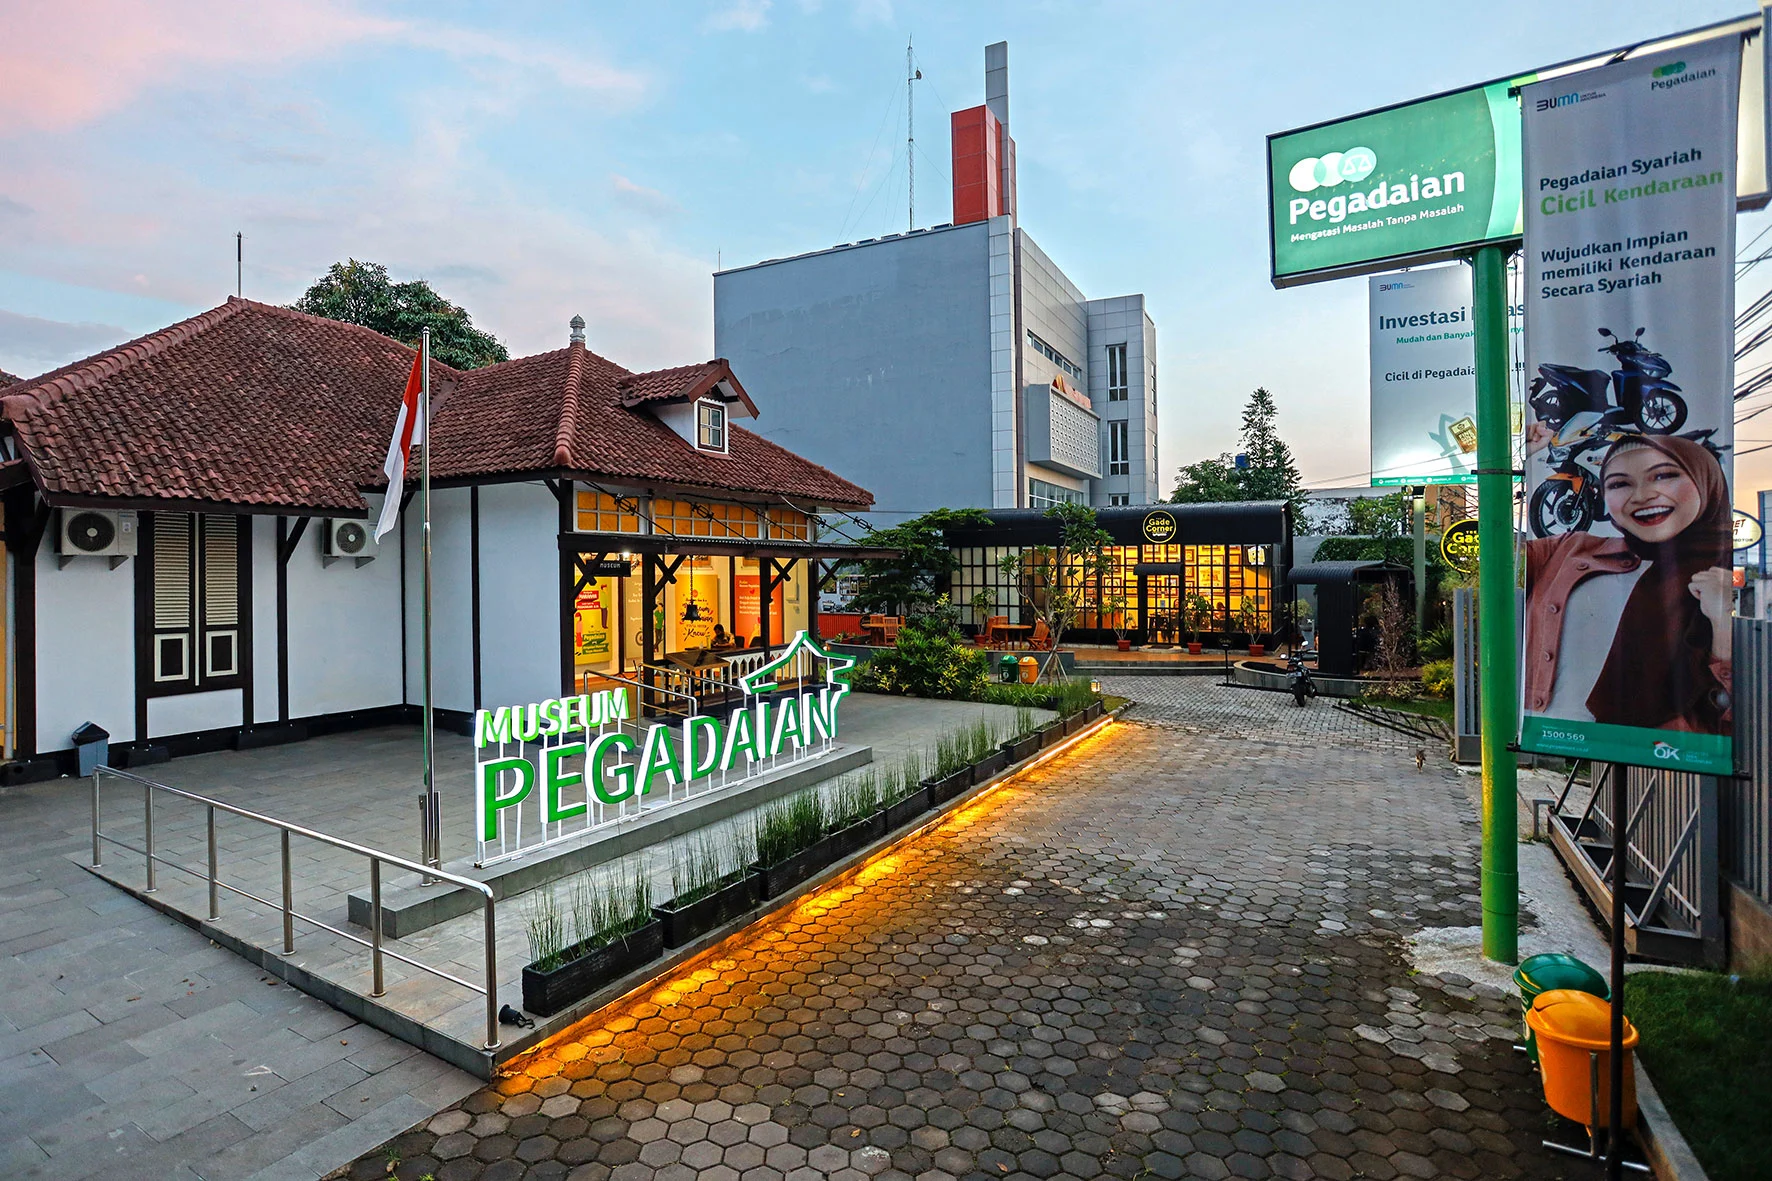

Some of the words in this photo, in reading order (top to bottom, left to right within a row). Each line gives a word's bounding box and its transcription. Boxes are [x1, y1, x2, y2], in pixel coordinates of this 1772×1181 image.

[1651, 67, 1716, 91] Pegadaian
[1540, 165, 1627, 191] Pegadaian
[1631, 148, 1702, 175] Syariah
[1289, 171, 1465, 225] Pegadaian
[1540, 188, 1597, 216] Cicil
[1604, 171, 1723, 204] Kendaraan
[1290, 226, 1341, 243] Mengatasi
[1342, 219, 1384, 234] Masalah
[1386, 213, 1417, 226] Tanpa
[1419, 203, 1464, 220] Masalah
[1541, 242, 1622, 264] Wujudkan
[1626, 230, 1688, 250] Impian
[1542, 258, 1612, 281] memiliki
[1619, 246, 1716, 270] Kendaraan
[1541, 283, 1594, 299] Secara
[1598, 271, 1662, 293] Syariah
[1379, 306, 1466, 330] Investasi
[1396, 333, 1425, 344] Mudah
[1426, 334, 1442, 342] dan
[1385, 370, 1410, 382] Cicil
[1412, 369, 1422, 380] di
[1425, 366, 1475, 381] Pegadaia
[1145, 525, 1174, 533] Corner
[1148, 518, 1171, 526] Gade
[474, 687, 630, 748] MUSEUM
[1542, 730, 1566, 739] 1500
[1566, 732, 1586, 742] 569
[476, 688, 839, 842] PEGADAIAN
